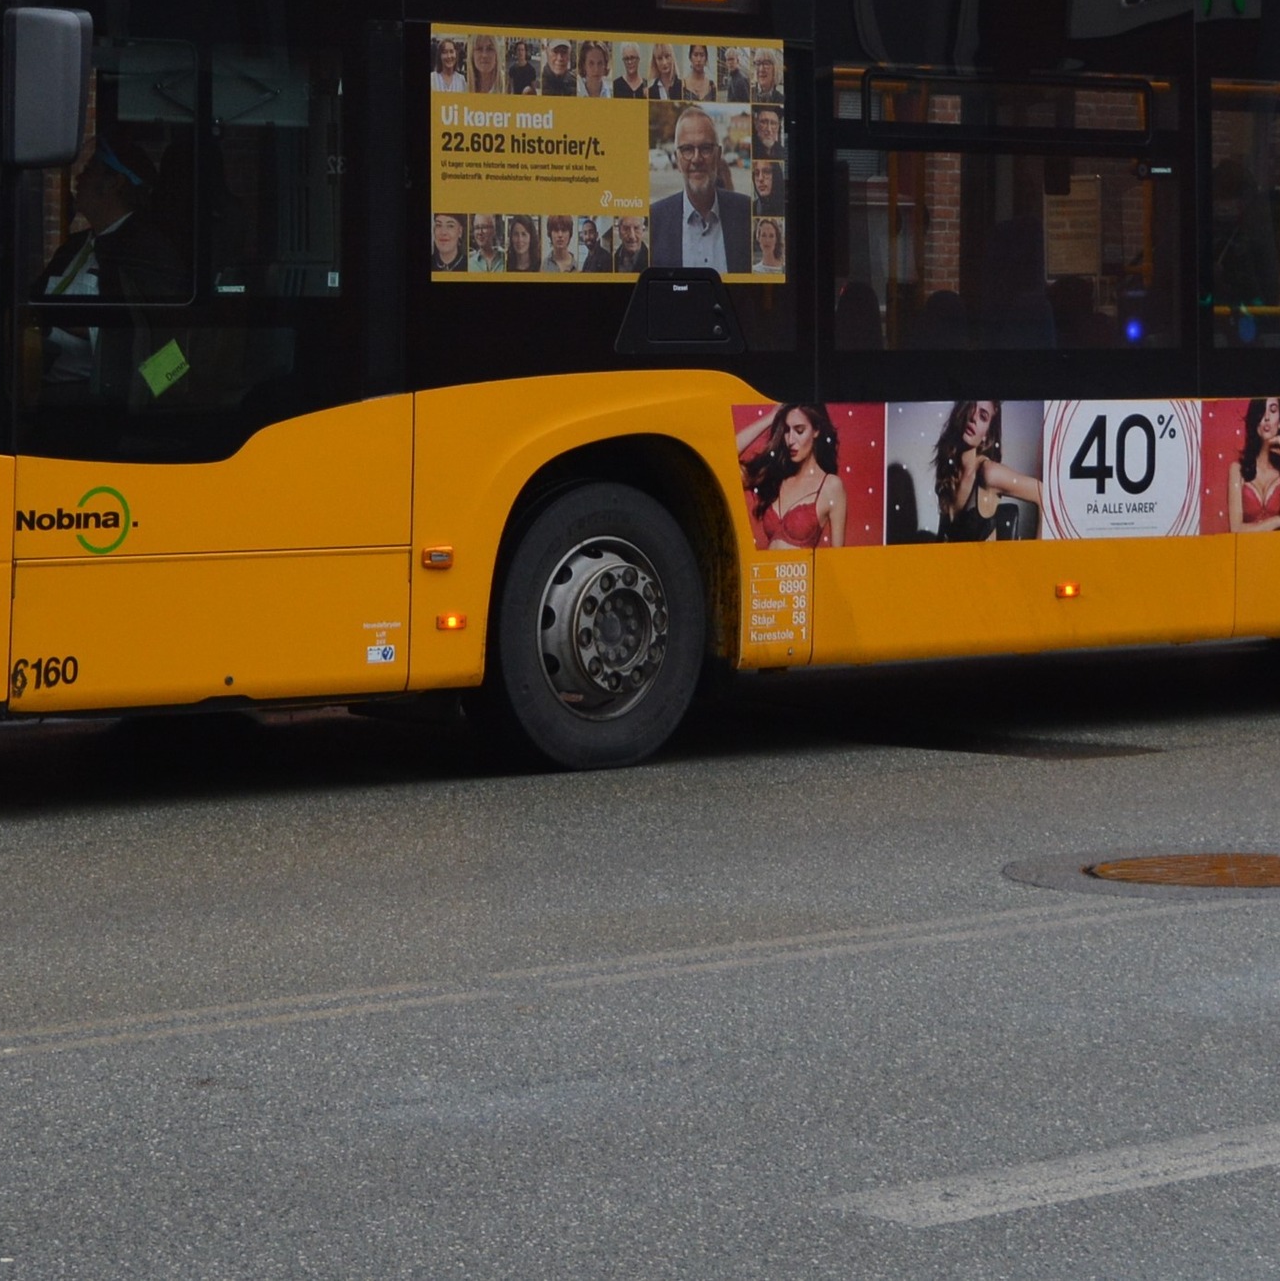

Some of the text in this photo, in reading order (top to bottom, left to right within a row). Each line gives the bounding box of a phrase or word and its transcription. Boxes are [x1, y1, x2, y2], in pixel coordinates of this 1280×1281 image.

[464, 106, 511, 128] kører
[516, 109, 554, 129] med
[441, 131, 605, 160] 22.602 historier/t.
[614, 195, 643, 208] movia
[1069, 413, 1176, 495] 40%
[1086, 500, 1099, 514] PÅ
[1101, 502, 1123, 514] ALLE
[774, 563, 807, 578] 18000
[779, 579, 806, 594] 6890
[792, 595, 806, 609] 36
[792, 611, 806, 625] 58
[801, 626, 807, 640] 1
[12, 656, 78, 692] 6160
